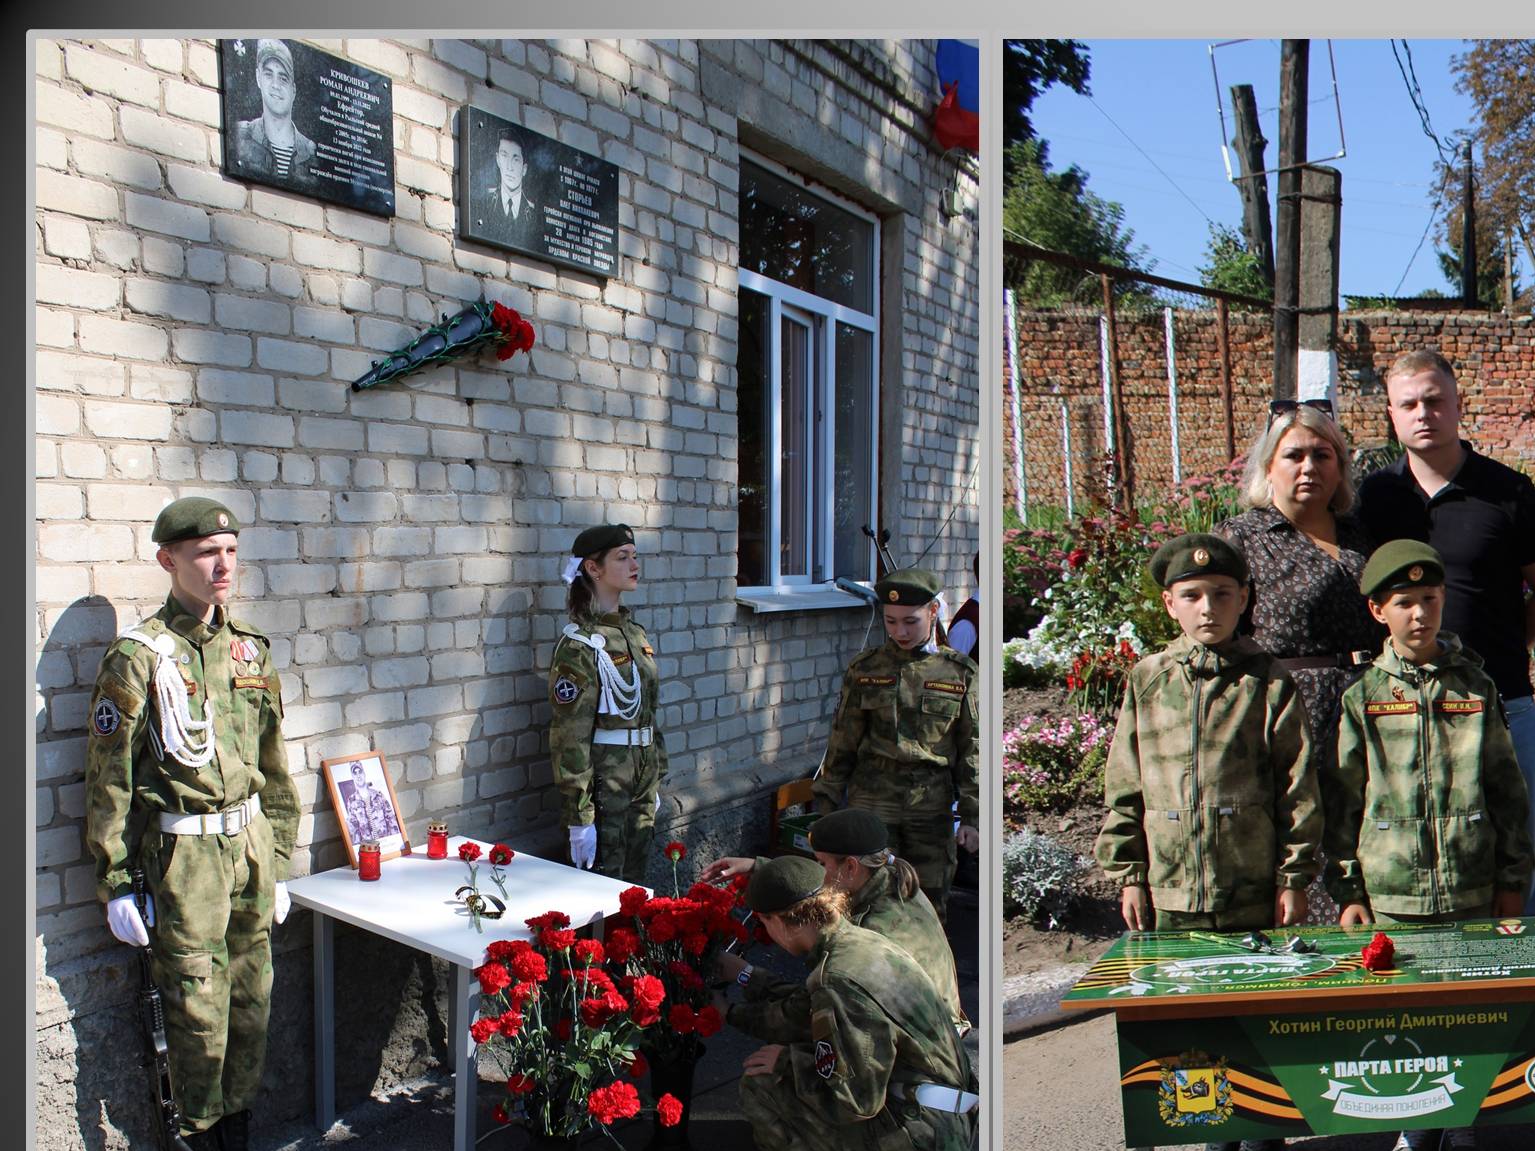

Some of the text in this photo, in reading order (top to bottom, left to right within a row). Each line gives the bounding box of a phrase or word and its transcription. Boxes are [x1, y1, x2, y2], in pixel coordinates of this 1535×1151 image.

[331, 69, 369, 89] КРИВОШЕЕВ
[320, 76, 380, 104] РОМАН АНДРЕЕВИЧ
[568, 189, 592, 206] СТОРЬЕВ
[1168, 967, 1295, 978] ПАРТА ГЕРОЯ
[1269, 1011, 1508, 1034] Хотин Георгий Дмитриевич
[1334, 1056, 1448, 1078] ПАРТА ГЕРОЯ
[1340, 1093, 1446, 1114] ОБЪЕДИНЯЯ ПОКОЛЕНИЯ
